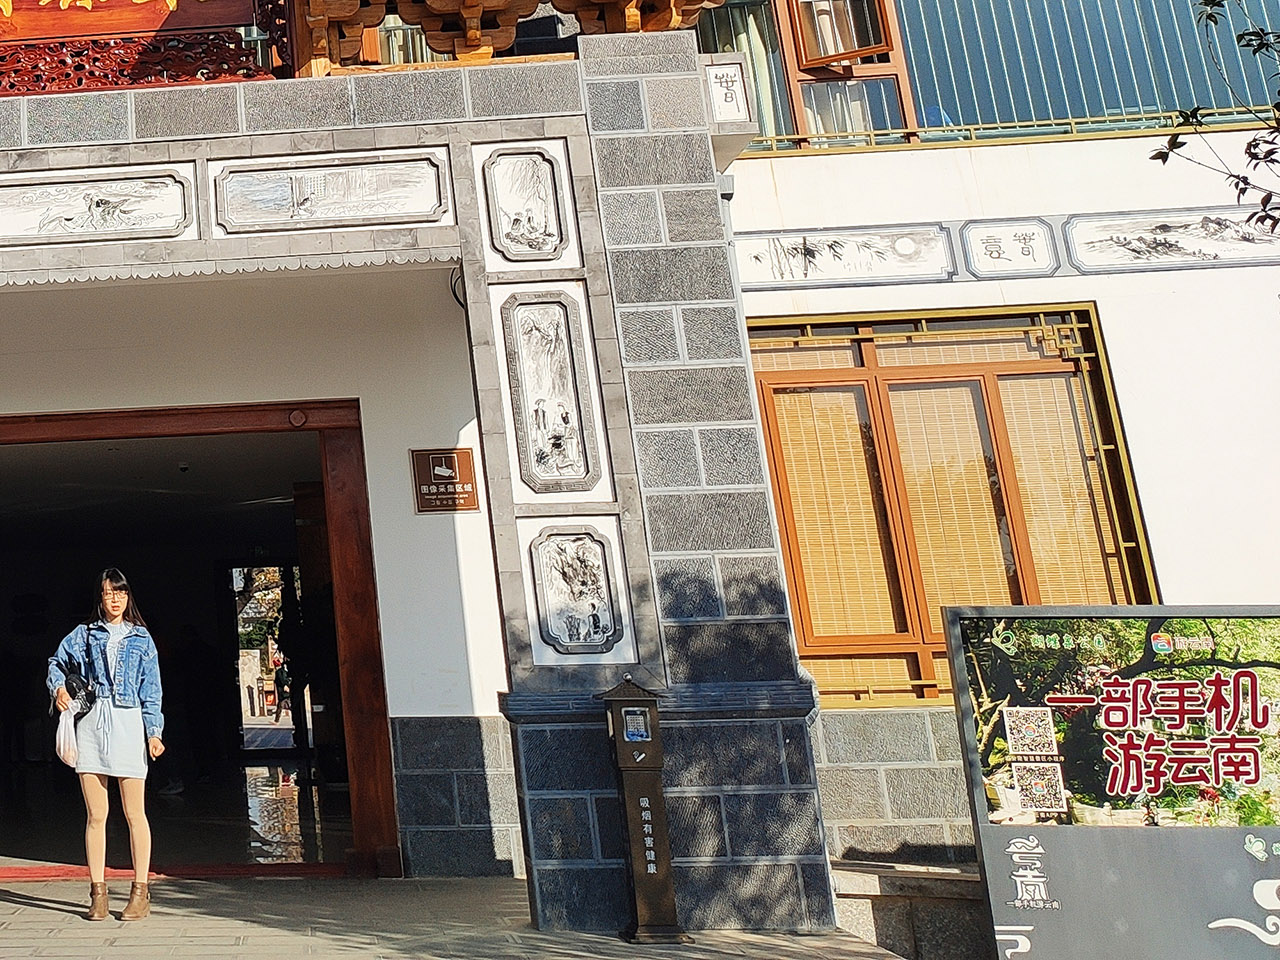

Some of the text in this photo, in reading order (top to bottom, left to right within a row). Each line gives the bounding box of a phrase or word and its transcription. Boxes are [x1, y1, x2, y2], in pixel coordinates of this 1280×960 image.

[1044, 669, 1269, 732] 一部手机
[1102, 733, 1262, 798] 游云南
[639, 797, 658, 874] 吸烟有害健康
